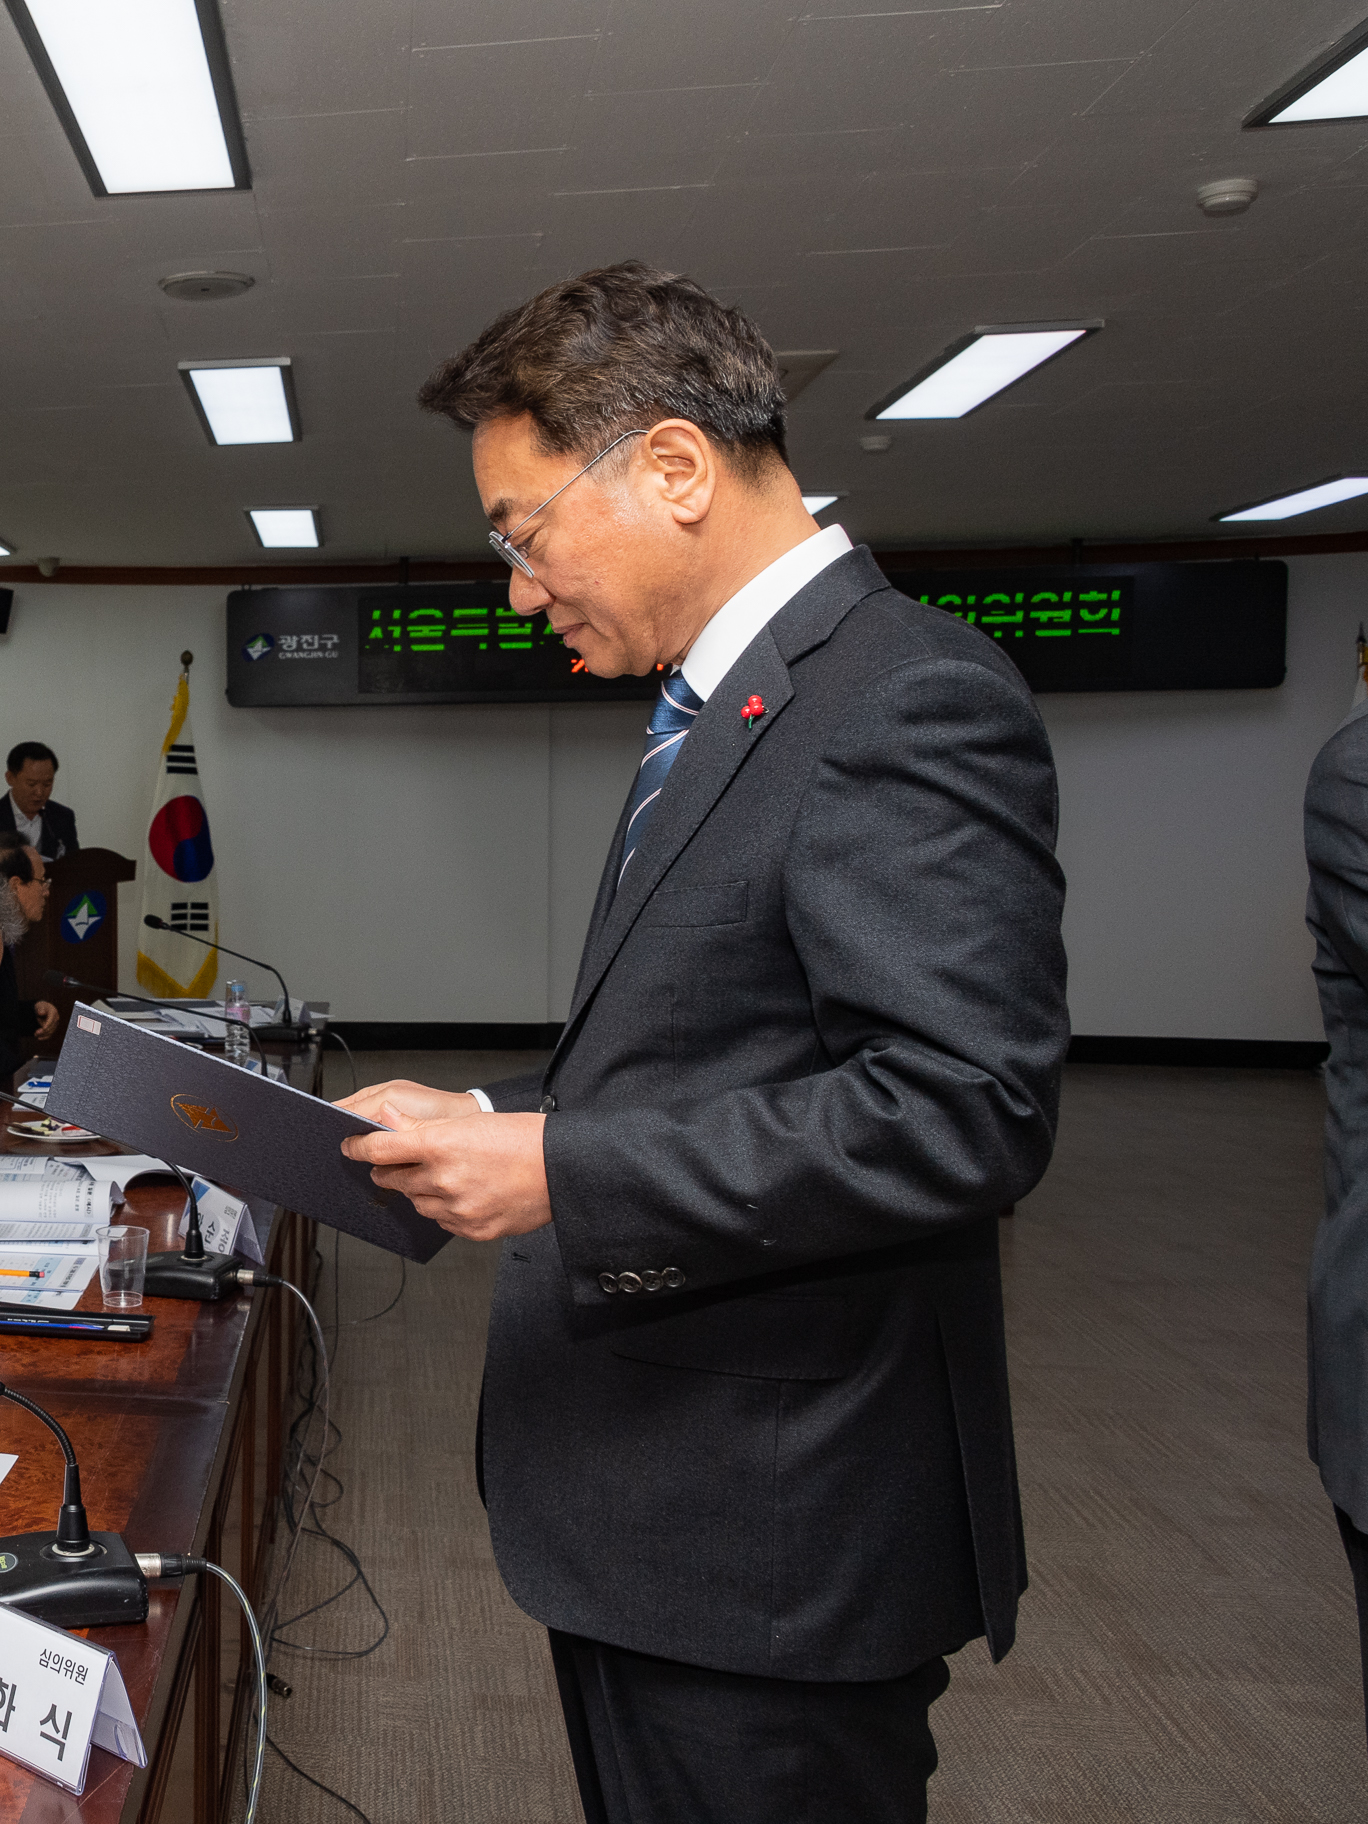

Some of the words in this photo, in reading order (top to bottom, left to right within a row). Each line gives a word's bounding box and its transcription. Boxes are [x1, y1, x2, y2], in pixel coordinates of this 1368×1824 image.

[278, 633, 339, 651] 광진구
[365, 608, 562, 652] 서울특별
[38, 1648, 90, 1686] 심의위원
[39, 1703, 73, 1762] 식
